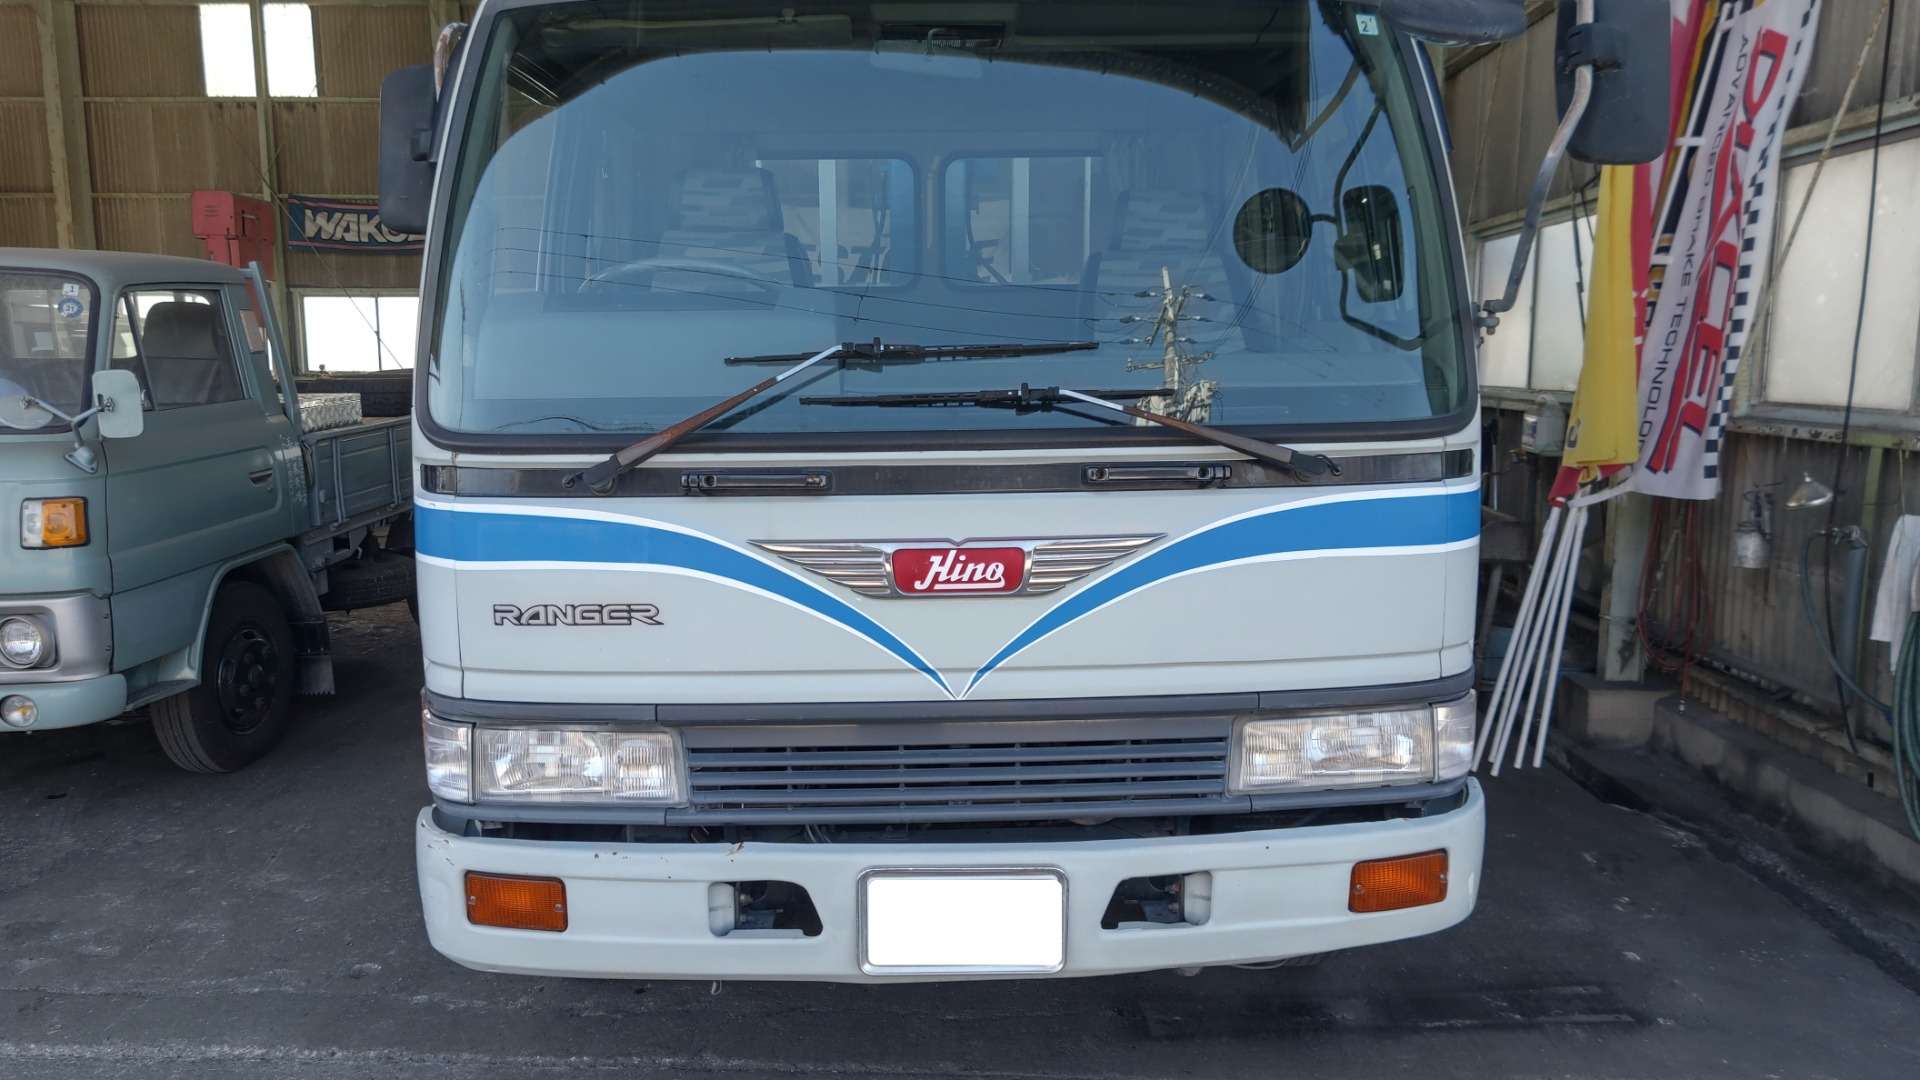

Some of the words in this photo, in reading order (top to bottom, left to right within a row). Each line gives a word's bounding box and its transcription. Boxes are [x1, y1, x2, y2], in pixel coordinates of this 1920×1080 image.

[304, 208, 426, 242] WAK
[914, 549, 1005, 590] Hino
[493, 604, 664, 626] RANGER
